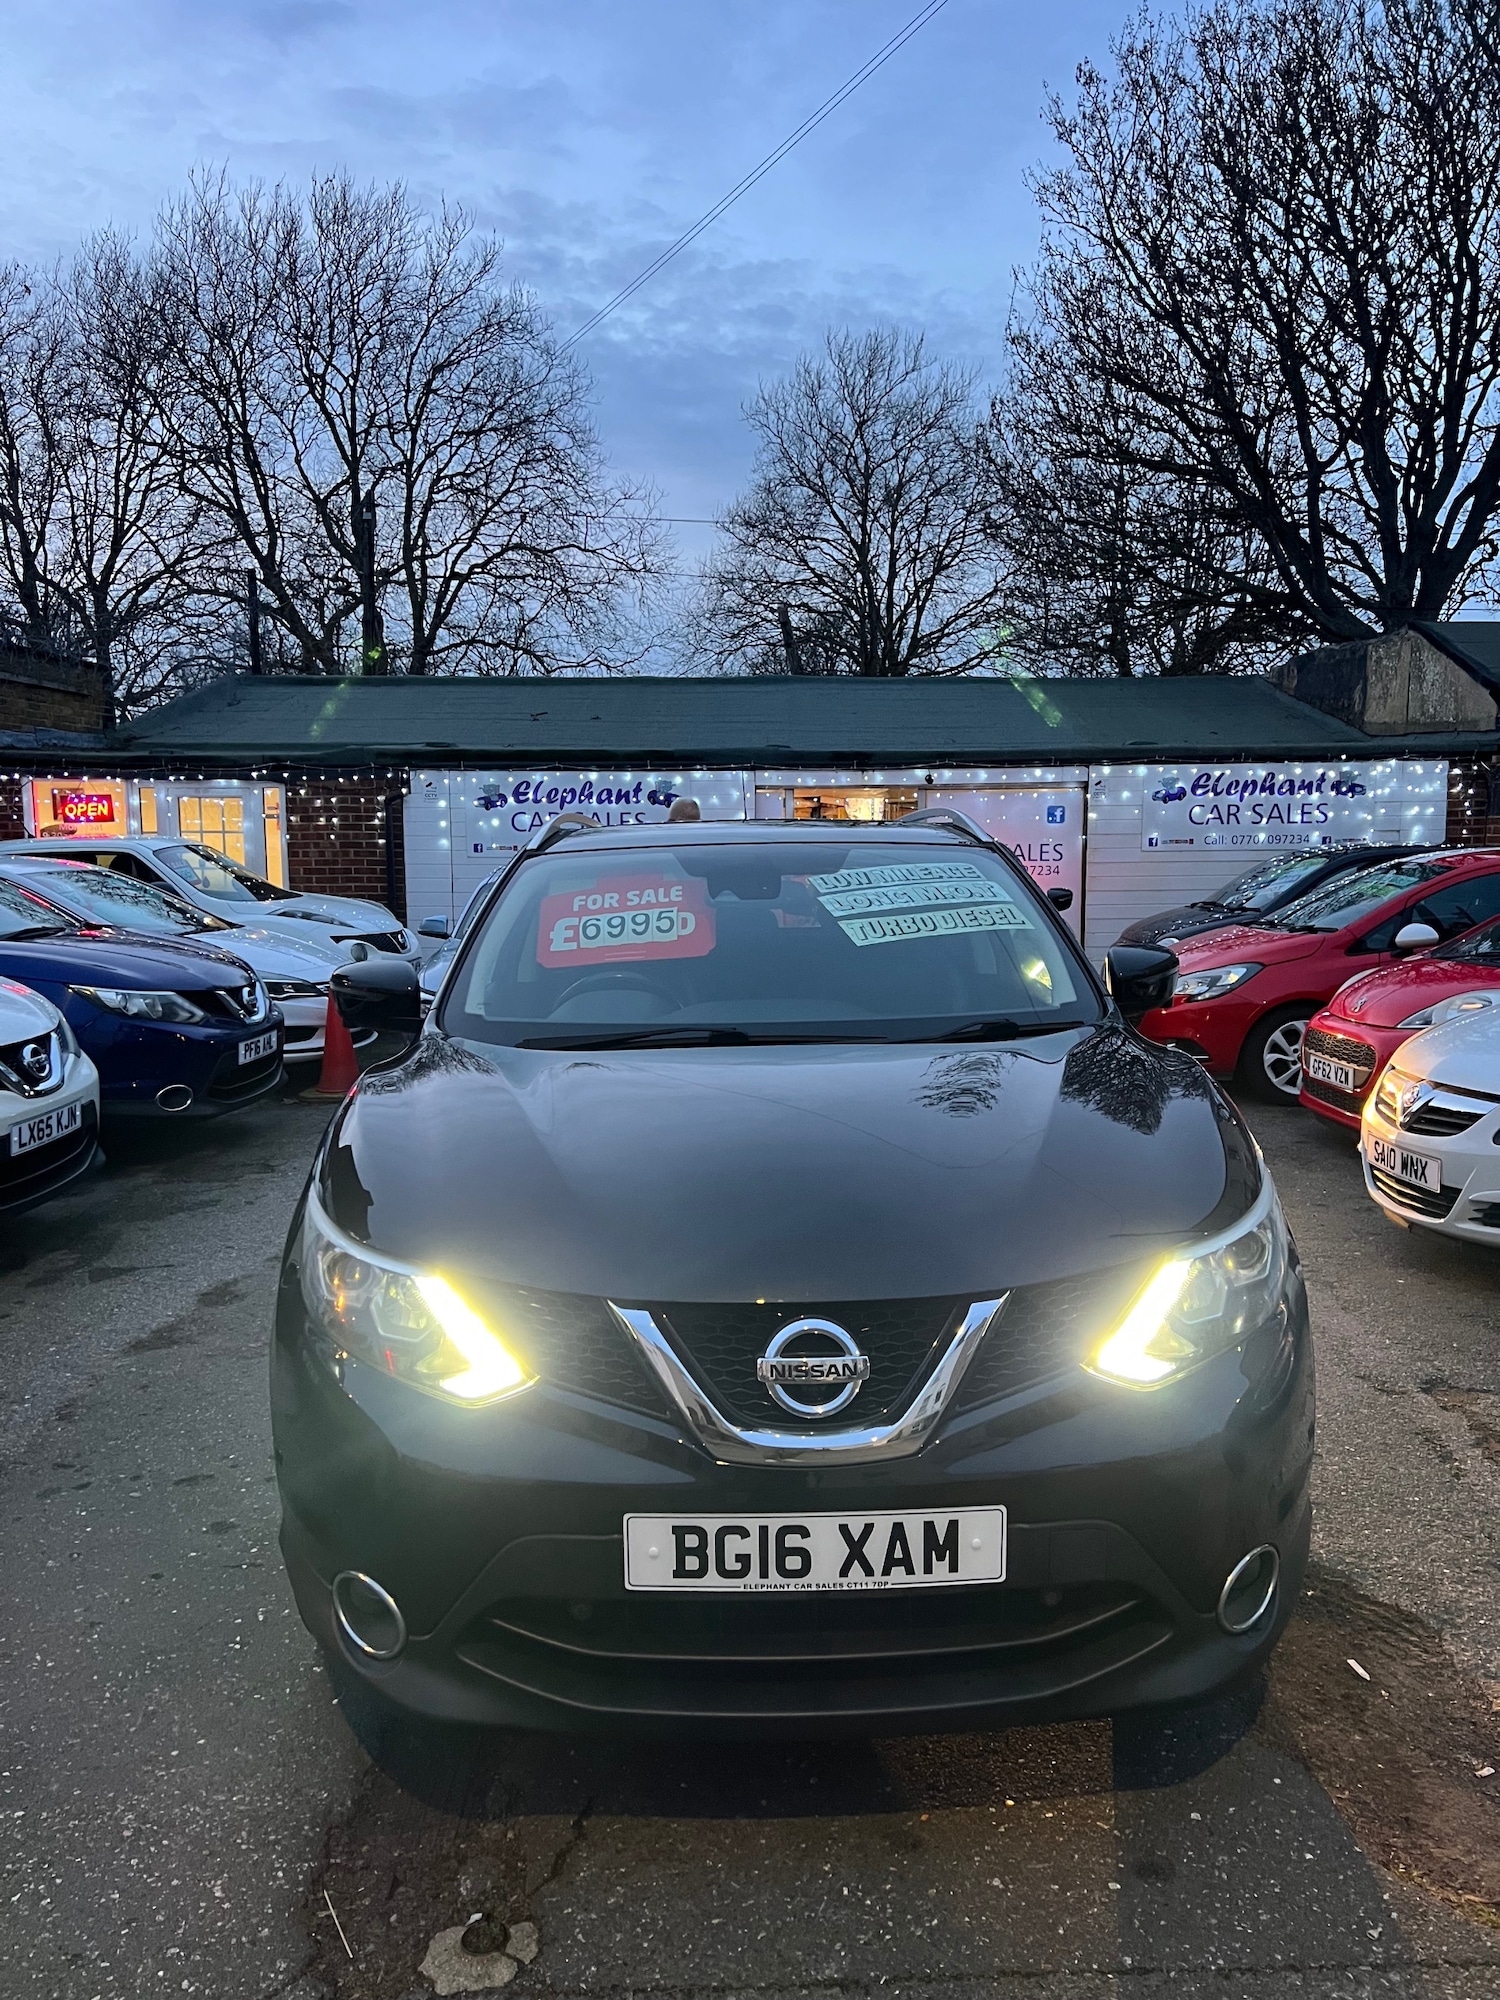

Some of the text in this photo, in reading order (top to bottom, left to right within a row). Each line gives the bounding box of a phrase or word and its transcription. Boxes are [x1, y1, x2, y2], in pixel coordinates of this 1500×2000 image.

[511, 780, 643, 811] Elephant
[1190, 772, 1326, 803] Elephant
[65, 803, 109, 817] OPEN
[575, 812, 647, 827] ALES
[1188, 803, 1330, 825] CAR SALES
[1008, 843, 1064, 862] ALES
[1203, 834, 1228, 846] Call:
[818, 864, 982, 890] LOW MILEAGE
[573, 885, 683, 912] FOR SALE
[827, 889, 915, 912] LONG
[849, 905, 1026, 941] TURBO DIESEL
[18, 1103, 77, 1149] LX65 KJN
[1374, 1140, 1428, 1184] SA10 WNX
[770, 1363, 858, 1378] NISSAN
[671, 1519, 960, 1580] BG16 XAM
